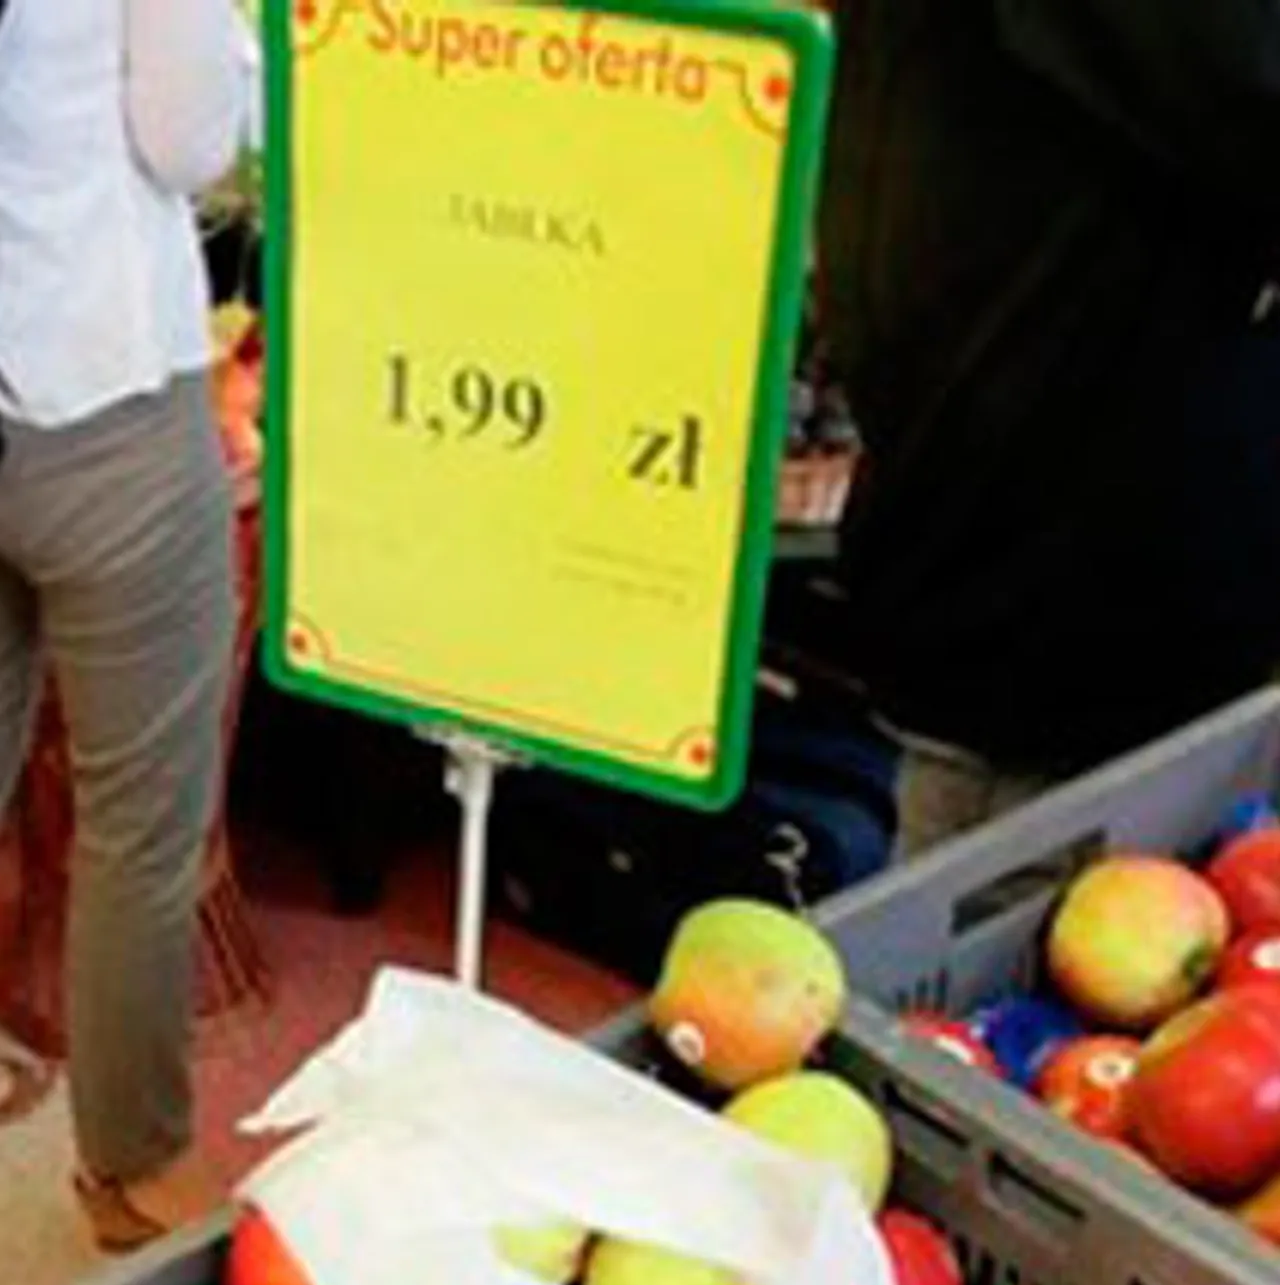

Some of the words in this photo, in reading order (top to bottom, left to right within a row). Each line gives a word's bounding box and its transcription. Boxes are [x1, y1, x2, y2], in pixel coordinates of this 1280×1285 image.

[367, 0, 527, 78] Super
[539, 10, 707, 104] oferta
[388, 354, 546, 450] 1,99
